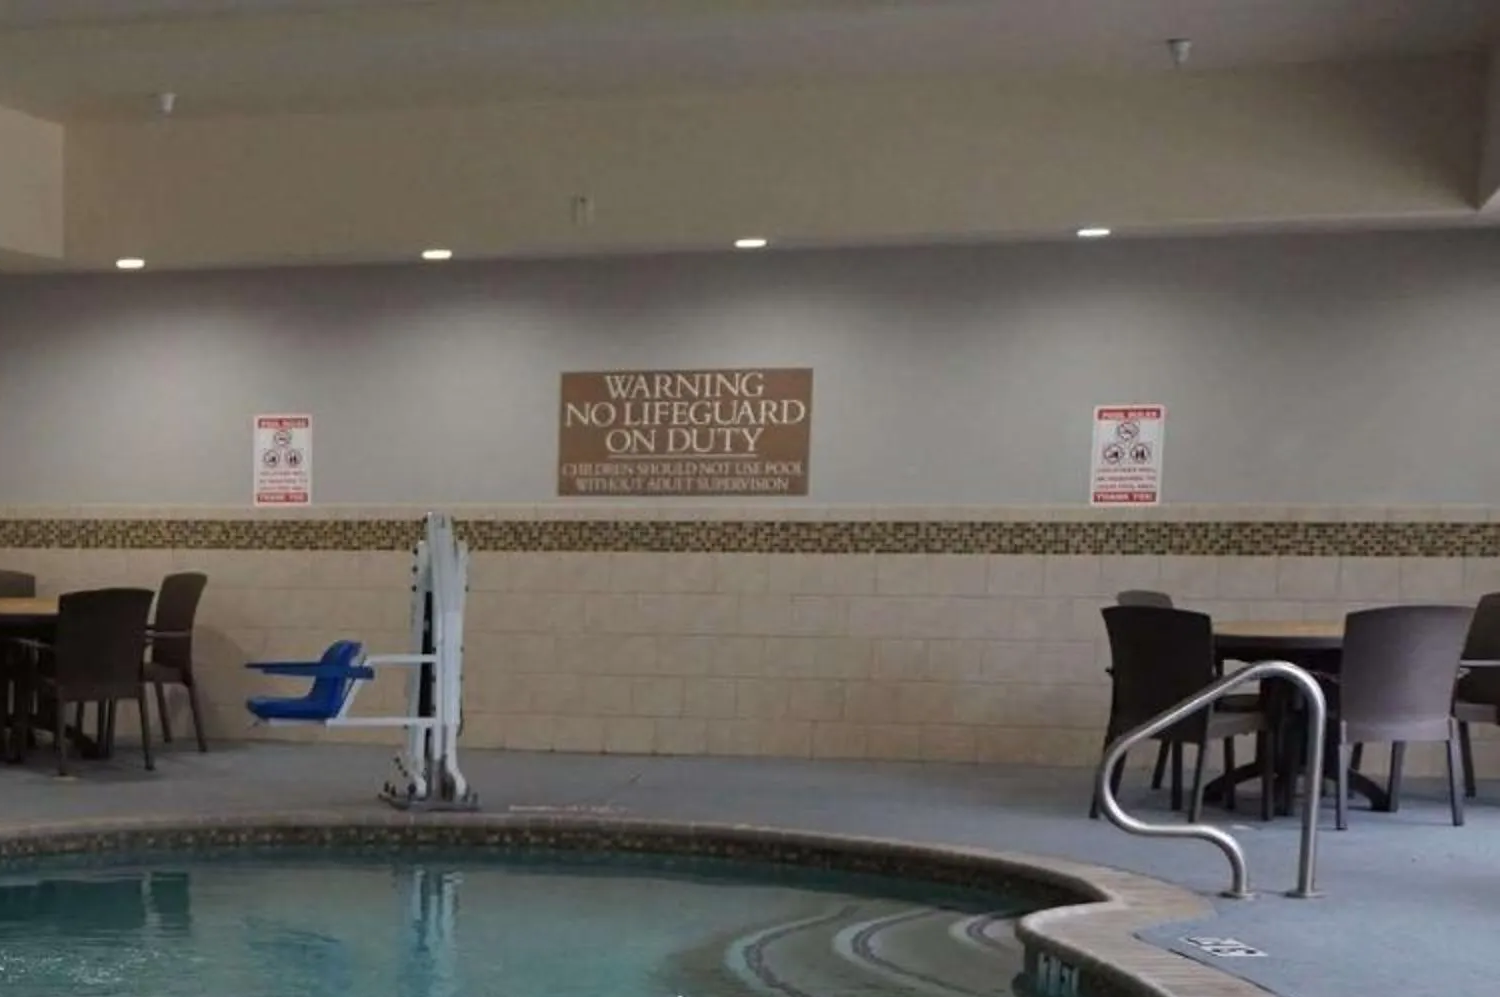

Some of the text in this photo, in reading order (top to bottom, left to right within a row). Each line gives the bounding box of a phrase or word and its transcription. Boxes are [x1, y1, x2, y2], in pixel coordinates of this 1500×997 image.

[605, 373, 764, 399] WARNING
[565, 399, 805, 427] NO LIFEGUARD
[605, 427, 764, 453] ON DUTY
[636, 462, 698, 476] SHOULD
[699, 461, 729, 475] NOT
[764, 461, 804, 475] POOL
[576, 477, 643, 492] WITHOUT
[698, 476, 790, 492] SUPERVISION
